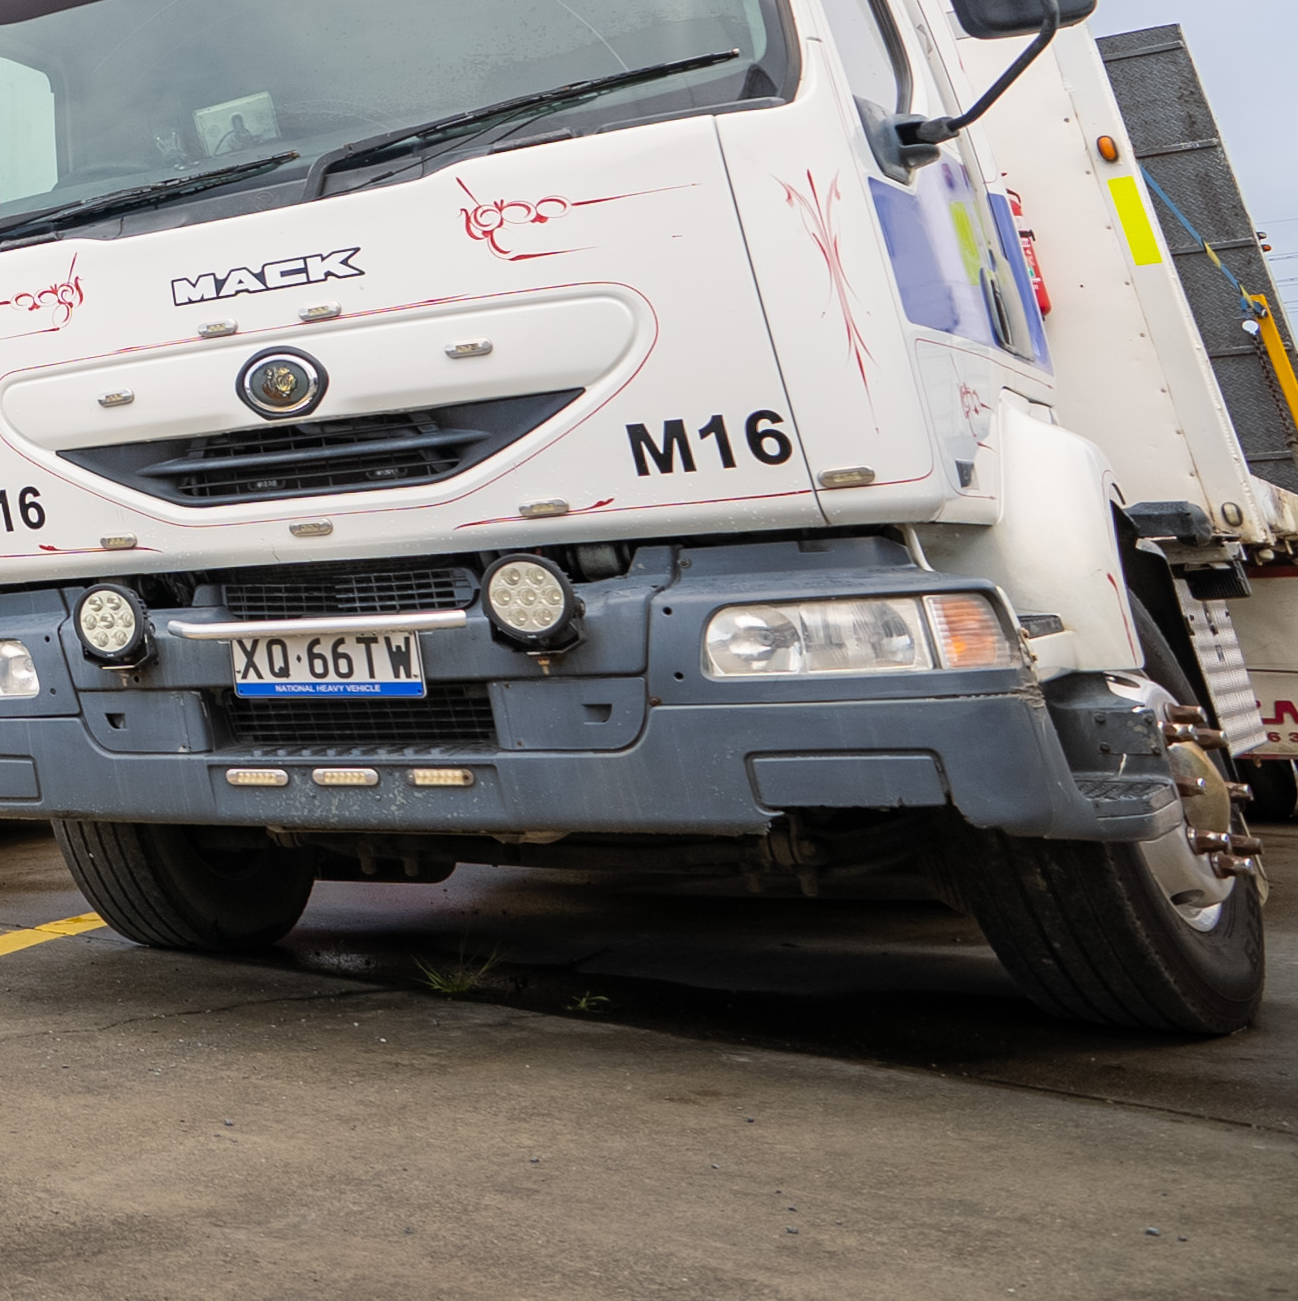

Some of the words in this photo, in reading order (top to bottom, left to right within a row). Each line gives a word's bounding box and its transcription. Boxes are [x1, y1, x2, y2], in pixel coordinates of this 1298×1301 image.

[171, 247, 365, 306] MACK
[625, 409, 792, 477] M16
[275, 684, 315, 693] NATIONAL
[316, 684, 345, 693] HEAVY
[345, 684, 381, 693] VEHICLE
